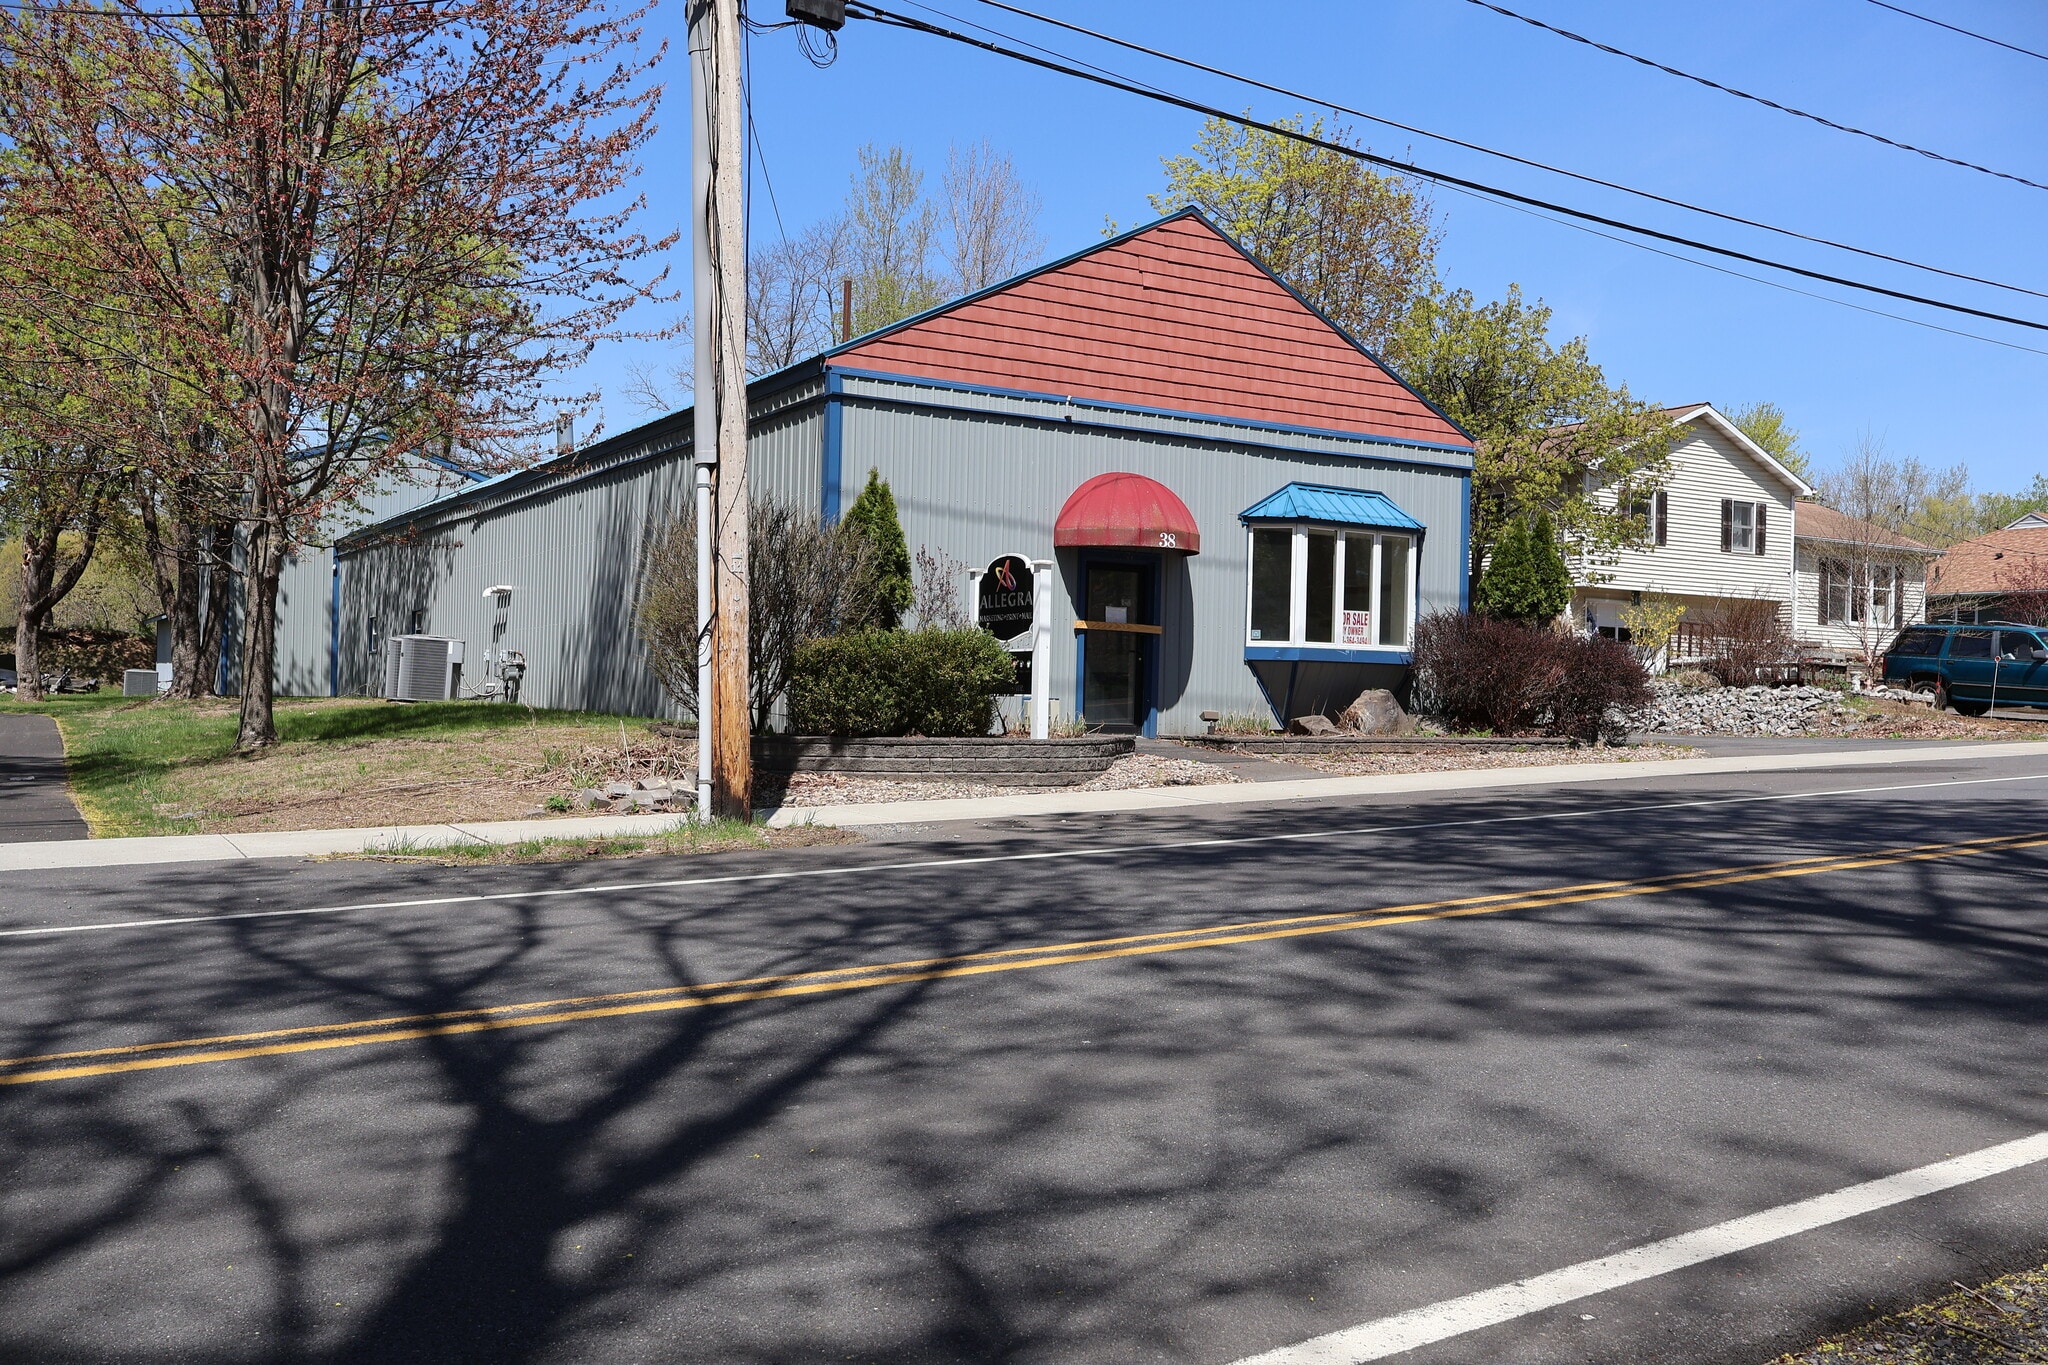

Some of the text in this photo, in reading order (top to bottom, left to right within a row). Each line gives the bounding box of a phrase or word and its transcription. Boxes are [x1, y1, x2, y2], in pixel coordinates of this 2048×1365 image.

[1158, 532, 1176, 548] 38
[979, 591, 1033, 609] ALLEGRA
[1352, 612, 1368, 626] SALE
[1348, 626, 1364, 635] OWNER
[1343, 636, 1368, 645] -364-3494
